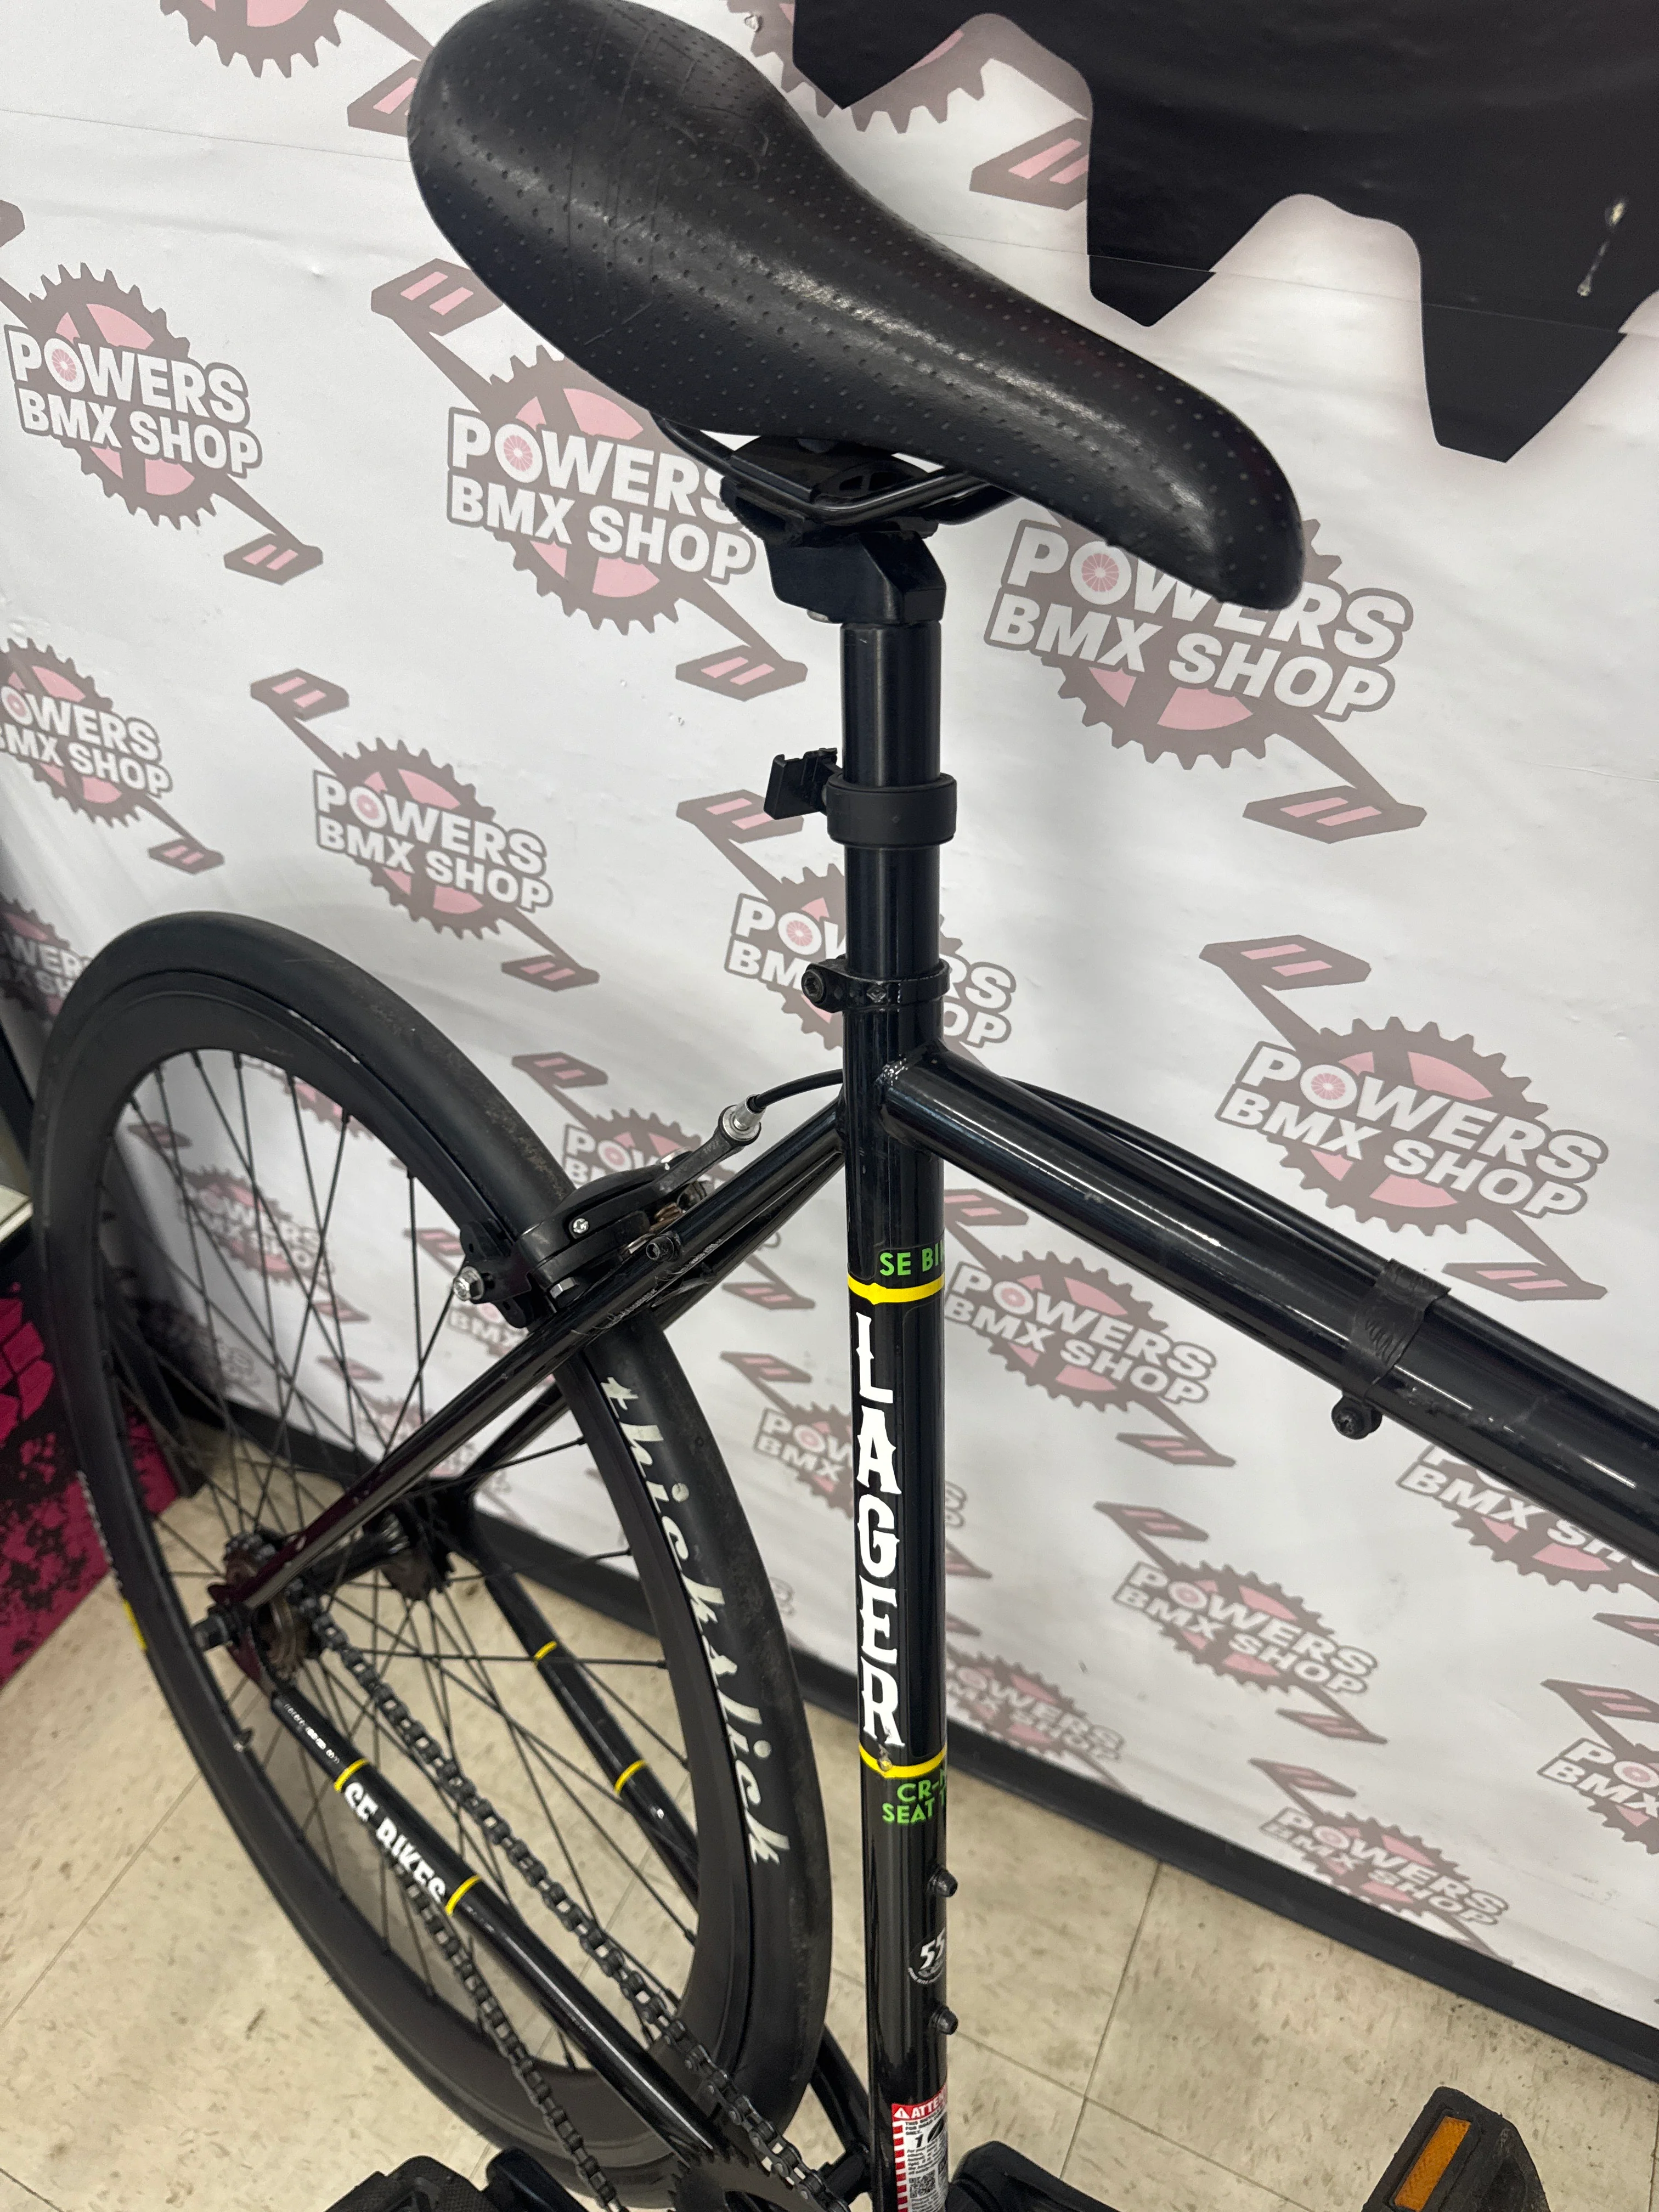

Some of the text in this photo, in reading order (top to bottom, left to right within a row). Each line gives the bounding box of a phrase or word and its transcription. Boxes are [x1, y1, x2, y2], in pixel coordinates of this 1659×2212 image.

[8, 330, 247, 424] POWERS
[18, 388, 258, 473] BMX SHOP
[452, 475, 751, 580] BMX SHOP
[989, 593, 1388, 715] BMX SHOP
[0, 685, 158, 760] OWERS
[0, 723, 168, 793] MX SHOP
[317, 774, 544, 874] POWERS
[319, 816, 549, 909] BMX SHOP
[1220, 1088, 1583, 1215] BMX SHOP
[1244, 1046, 1602, 1180] POWERS
[879, 1252, 911, 1276] SE
[944, 1294, 1206, 1403] BMX SHOP
[952, 1265, 1212, 1379] POWERS
[758, 1435, 846, 1482] BMX
[1400, 1464, 1547, 1531] BMX
[855, 1311, 906, 1750] LAGER
[1118, 1588, 1367, 1692] BMX SHOP
[1129, 1566, 1374, 1676] POWERS
[882, 1796, 935, 1824] SEAT
[1276, 1810, 1505, 1914] POWERS
[1367, 1869, 1499, 1925] SHOP
